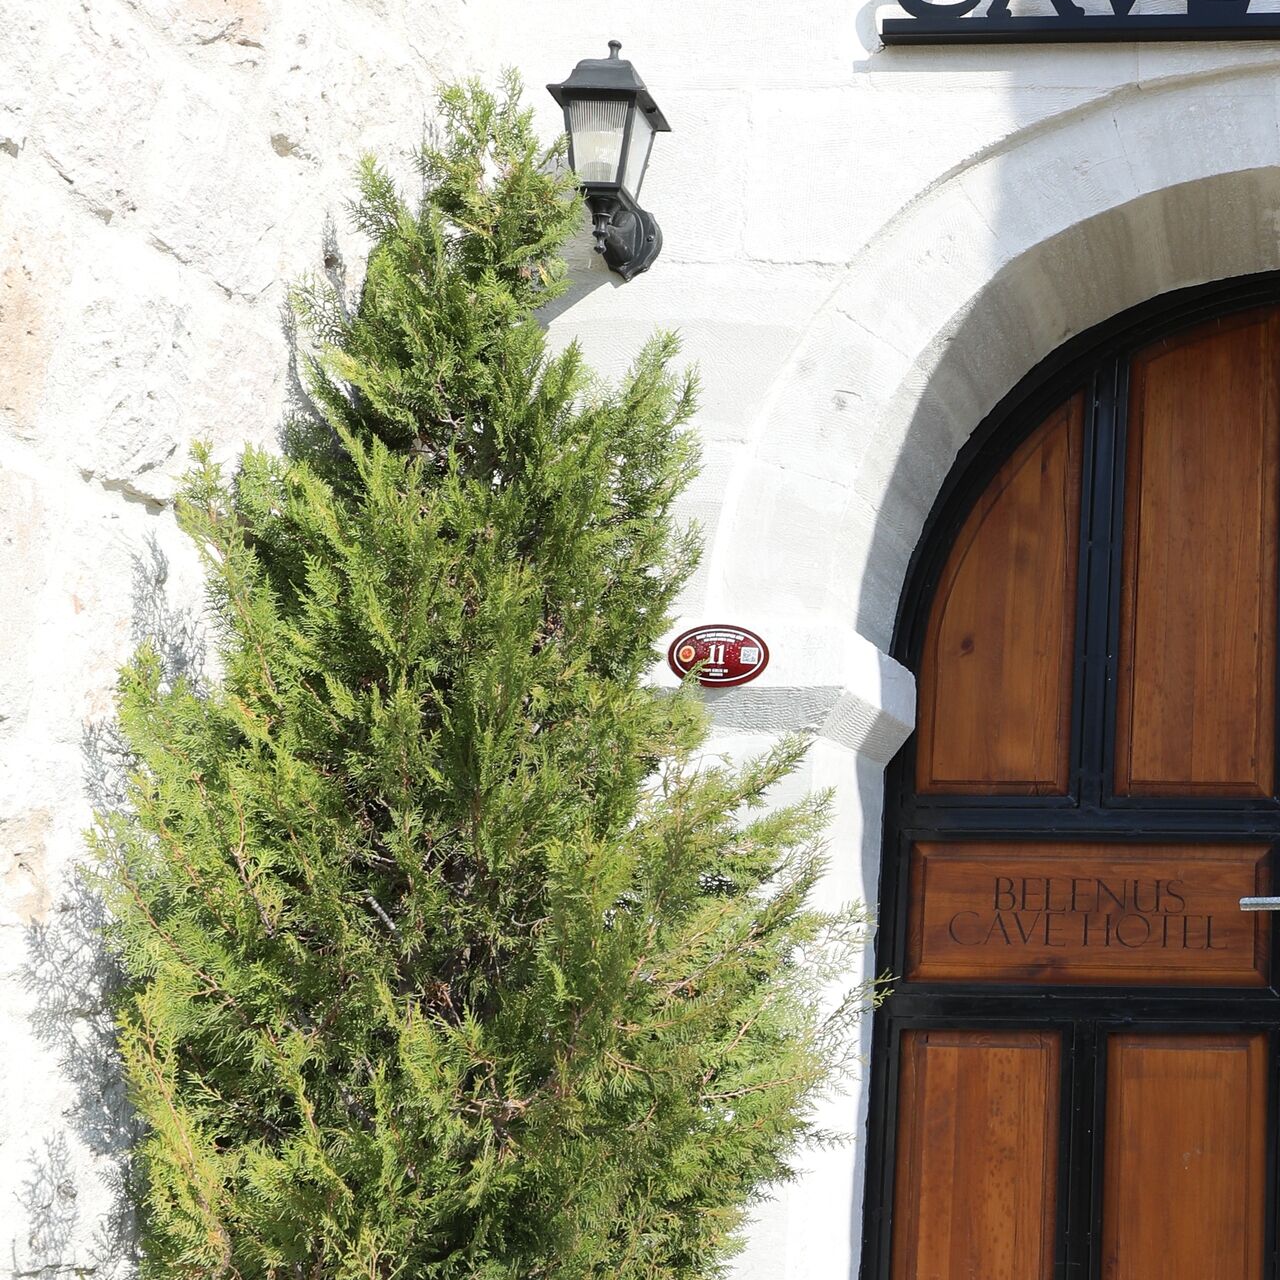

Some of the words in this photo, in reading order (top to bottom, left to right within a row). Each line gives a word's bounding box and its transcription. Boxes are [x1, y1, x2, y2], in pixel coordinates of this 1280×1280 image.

[708, 644, 726, 665] 11
[992, 876, 1186, 914] BELENUS
[948, 910, 1066, 947] CAVE
[1081, 912, 1229, 950] HOTEL
